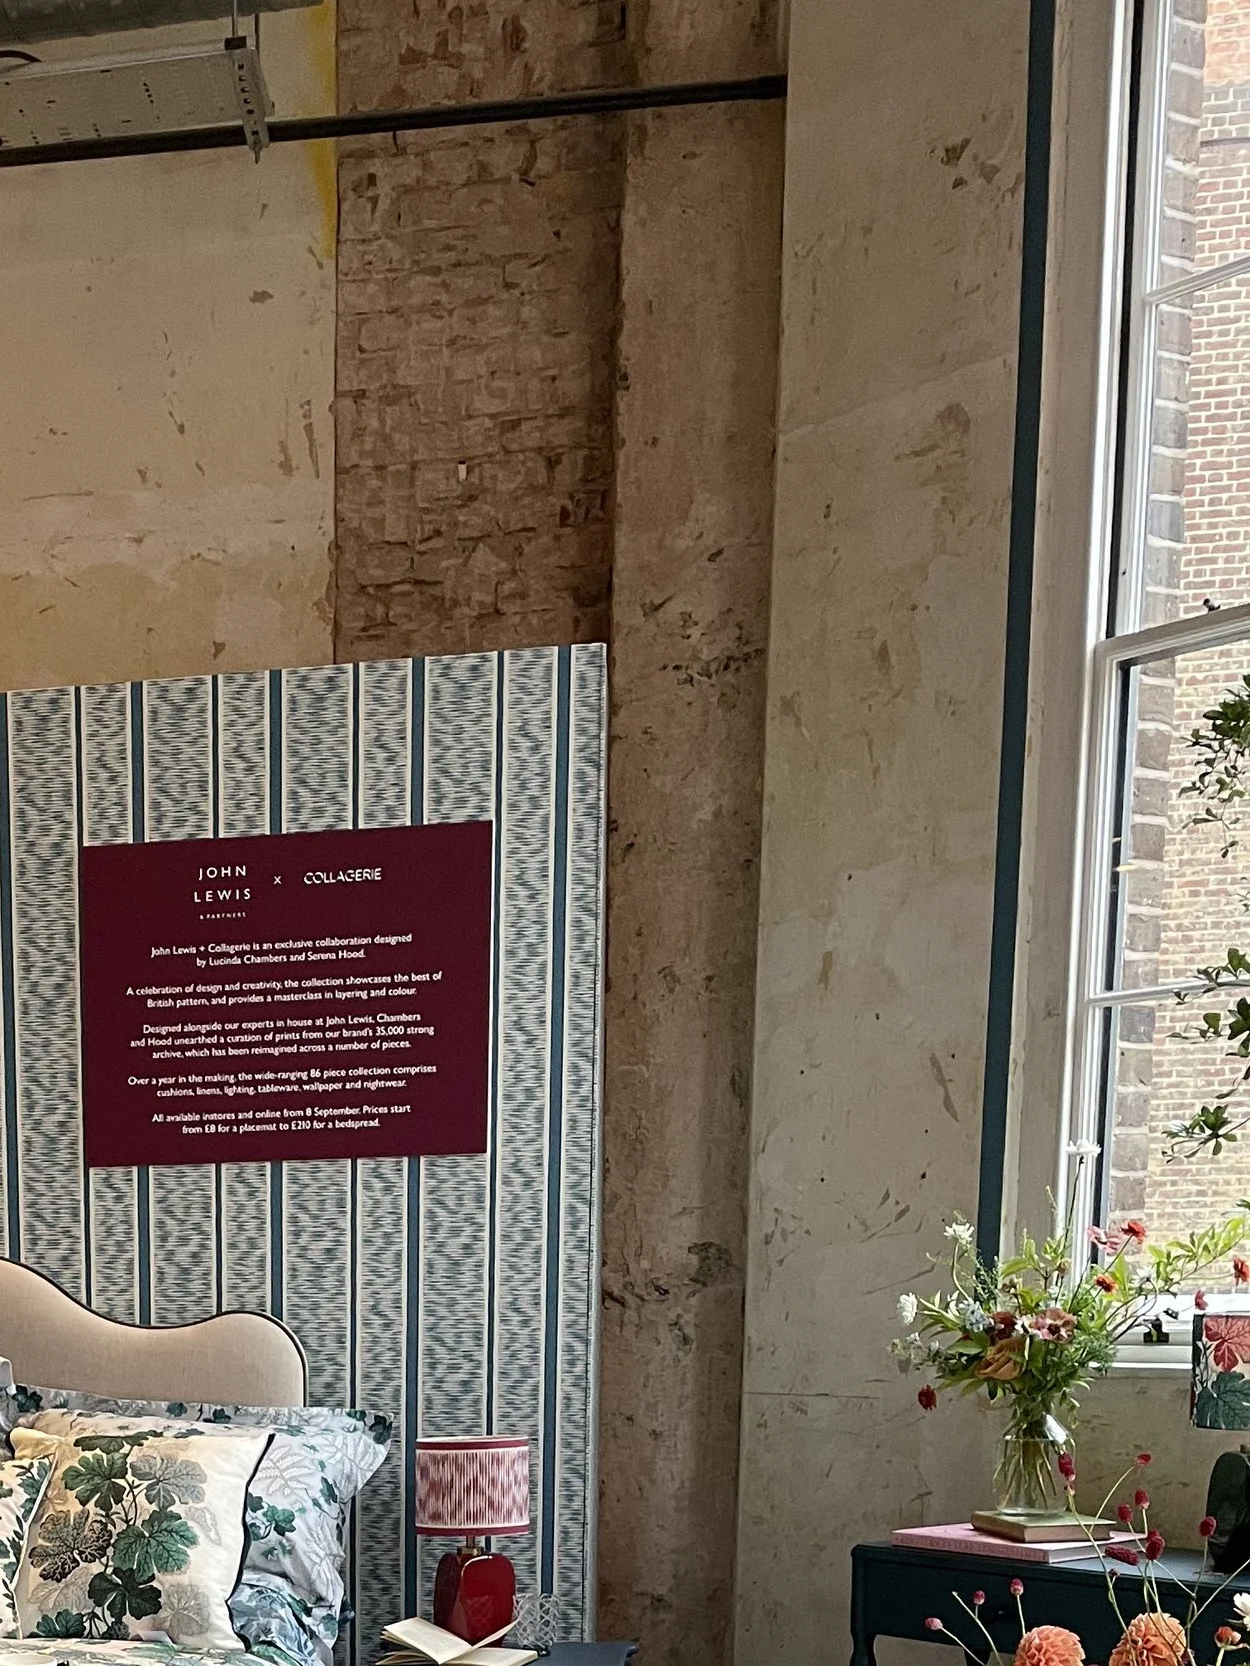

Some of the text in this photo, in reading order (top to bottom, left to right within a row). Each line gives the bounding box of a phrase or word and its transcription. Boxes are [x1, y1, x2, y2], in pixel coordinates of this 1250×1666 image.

[198, 865, 247, 881] JOHN
[303, 867, 382, 885] COLLAGERIE
[194, 888, 251, 903] LEWIS
[151, 946, 171, 957] John
[172, 945, 196, 954] Lewis
[208, 942, 251, 953] Collagerie
[252, 941, 260, 950] is
[274, 939, 313, 949] exclusive
[315, 936, 372, 946] collaboration
[374, 933, 412, 944] designed
[196, 949, 366, 968] by Lucinda Chambers and Serena Hood.
[126, 987, 135, 996] A
[136, 985, 183, 995] celebration
[184, 984, 194, 993] of
[196, 983, 222, 993] design
[224, 981, 240, 991] and
[284, 979, 299, 988] the
[301, 977, 344, 987] collection
[345, 976, 392, 984] showcases
[394, 973, 409, 982] the
[411, 972, 430, 981] best
[432, 971, 442, 980] of
[147, 998, 174, 1007] British
[211, 995, 226, 1004] and
[228, 994, 264, 1005] provides
[274, 991, 322, 1001] masterclass
[324, 990, 333, 999] in
[335, 989, 368, 1000] layering
[370, 987, 386, 996] and
[143, 1023, 182, 1035] Designed
[183, 1022, 222, 1033] alongside
[242, 1020, 274, 1030] experts
[276, 1018, 285, 1027] in
[286, 1018, 313, 1027] house
[315, 1017, 324, 1025] at
[325, 1016, 346, 1027] John
[376, 1013, 421, 1022] Chambers
[130, 1038, 145, 1047] and
[147, 1036, 172, 1046] Hood
[174, 1034, 218, 1045] unearthed
[227, 1033, 262, 1042] curation
[264, 1032, 273, 1040] of
[275, 1031, 300, 1042] prints
[302, 1030, 323, 1039] from
[406, 1026, 434, 1035] strong
[185, 1048, 210, 1057] which
[211, 1047, 226, 1056] has
[228, 1047, 249, 1055] been
[251, 1044, 297, 1055] reimagined
[335, 1041, 368, 1050] number
[370, 1040, 380, 1049] of
[382, 1040, 412, 1050] pieces.
[128, 1076, 149, 1085] Over
[158, 1077, 176, 1086] year
[178, 1074, 186, 1083] in
[188, 1074, 203, 1082] the
[238, 1072, 253, 1080] the
[254, 1069, 308, 1080] wide-ranging
[310, 1068, 321, 1077] 86
[323, 1068, 346, 1079] piece
[348, 1066, 391, 1076] collection
[392, 1064, 437, 1075] comprises
[302, 1082, 342, 1092] wallpaper
[345, 1080, 362, 1089] and
[364, 1079, 407, 1090] nightwear.
[152, 1104, 412, 1122] All available instores and online from 8 September. Prices start
[182, 1125, 202, 1133] from
[204, 1124, 216, 1132] £8
[218, 1123, 230, 1132] for
[239, 1122, 277, 1133] placemat
[279, 1122, 289, 1130] to
[291, 1120, 311, 1129] £210
[312, 1120, 325, 1128] for
[334, 1118, 380, 1129] bedspread.
